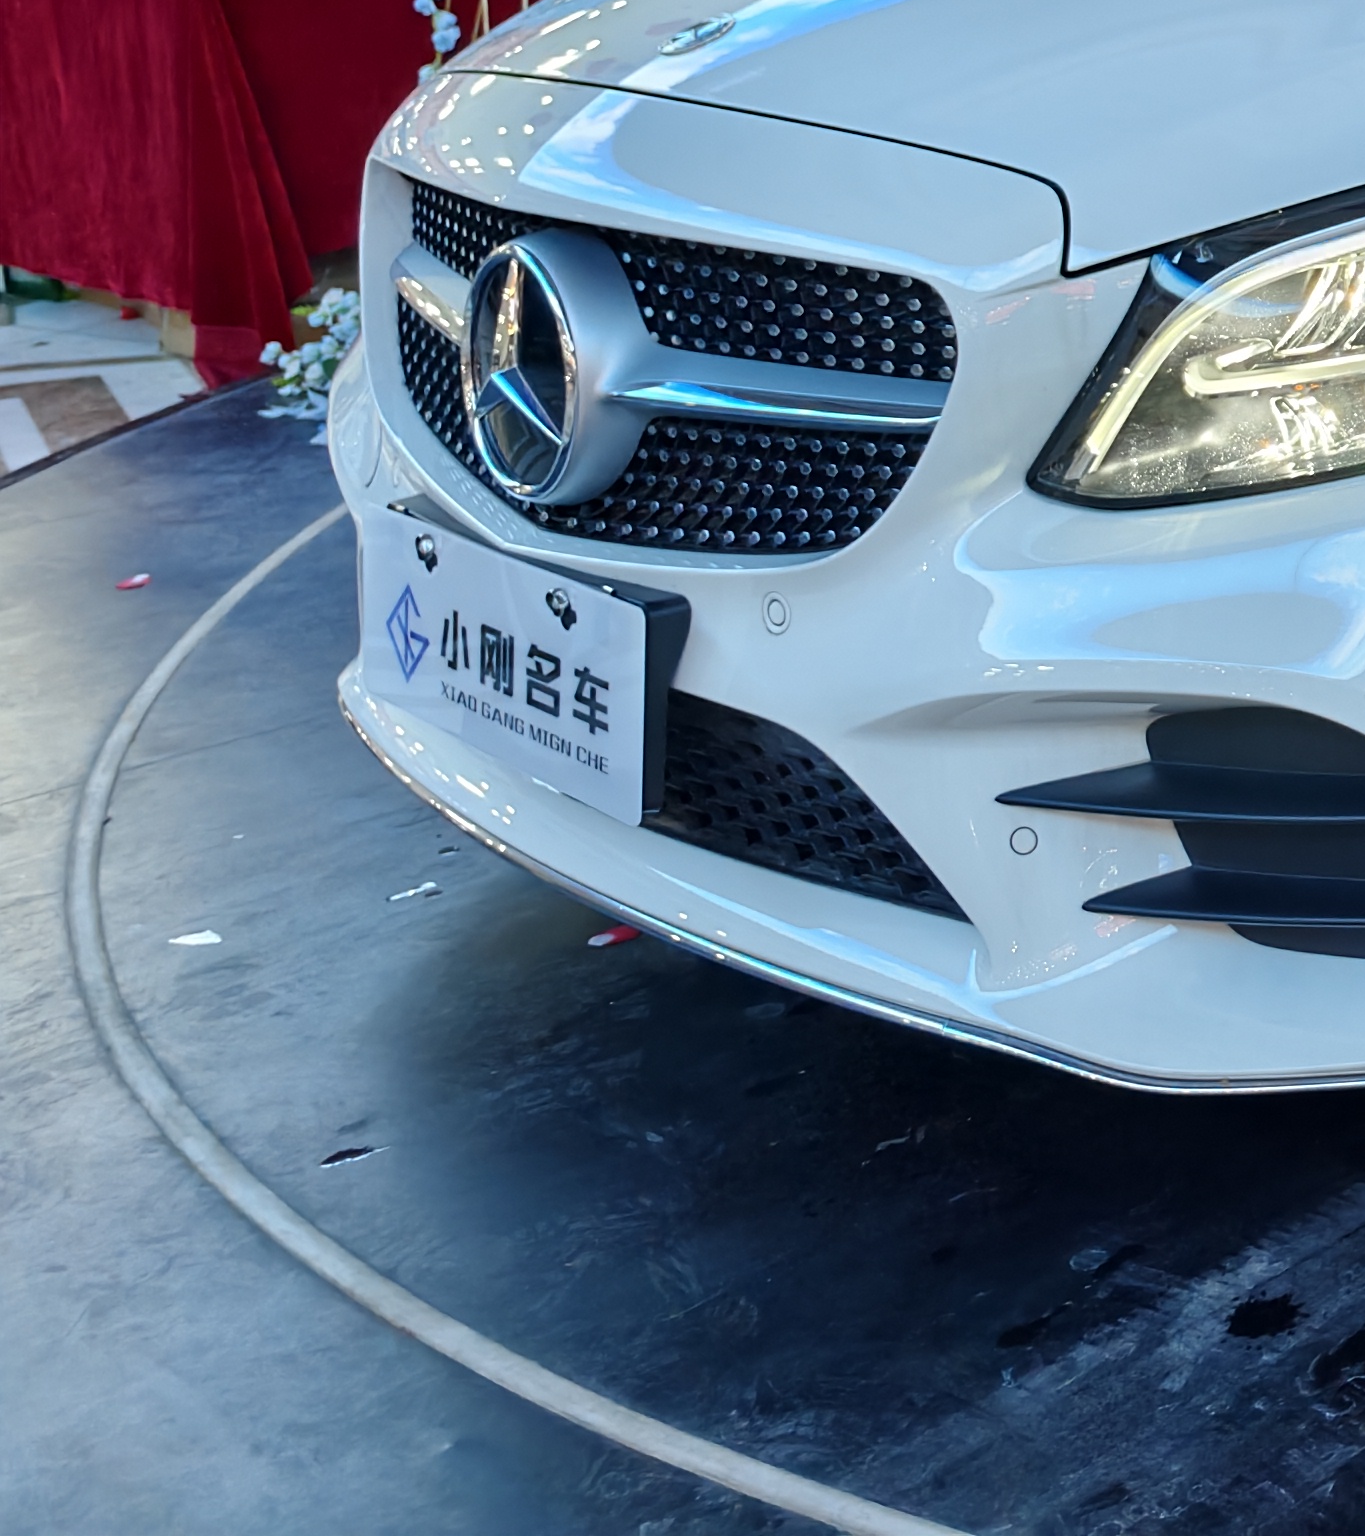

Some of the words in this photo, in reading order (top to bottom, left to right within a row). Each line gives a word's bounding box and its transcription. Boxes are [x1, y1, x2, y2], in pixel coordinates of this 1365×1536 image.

[440, 609, 609, 736] 小刚名车
[440, 679, 478, 714] XIAO
[480, 701, 525, 736] GANG
[528, 724, 572, 758] MIGN
[575, 745, 610, 775] CHE
